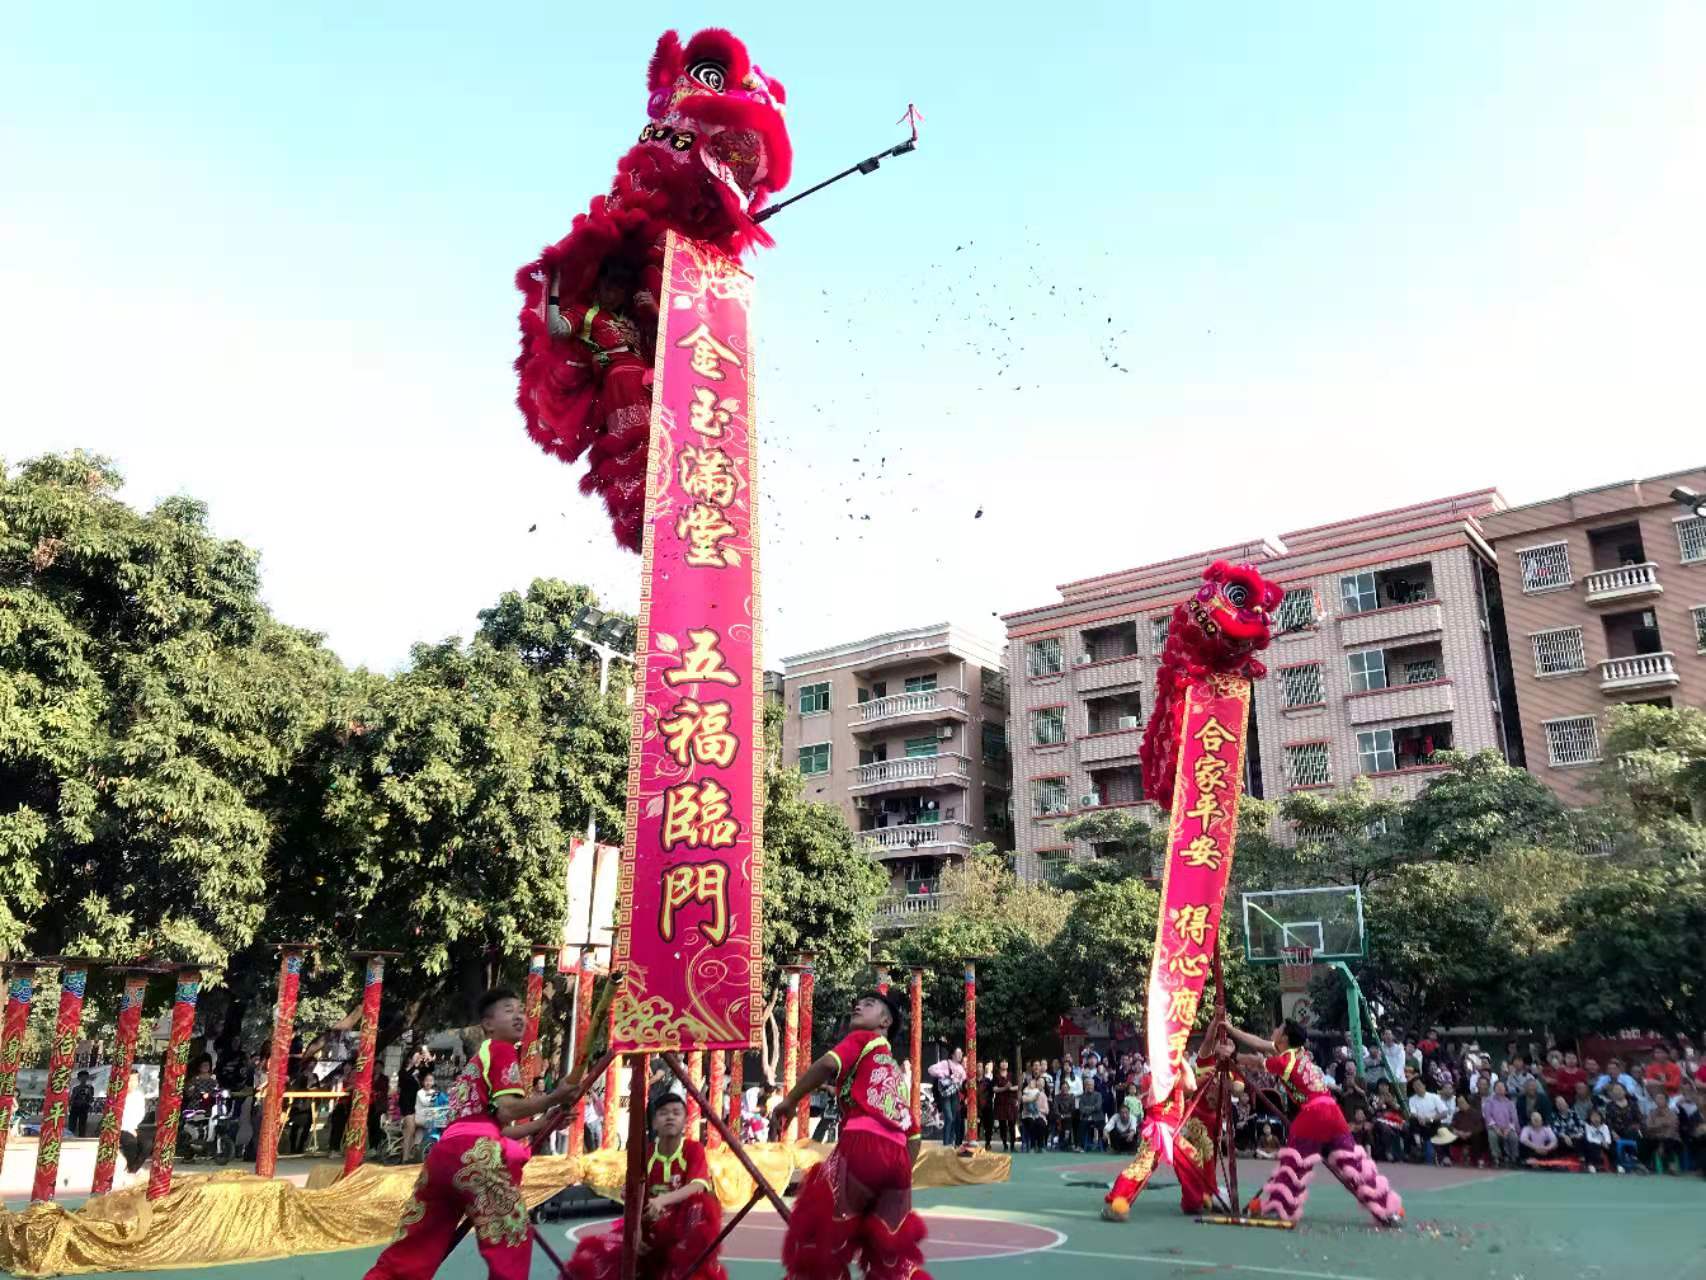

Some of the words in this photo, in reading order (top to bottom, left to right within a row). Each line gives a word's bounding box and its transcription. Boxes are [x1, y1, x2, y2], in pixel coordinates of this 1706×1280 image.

[657, 627, 740, 948] 五福臨門
[1178, 717, 1237, 870] 合家平安
